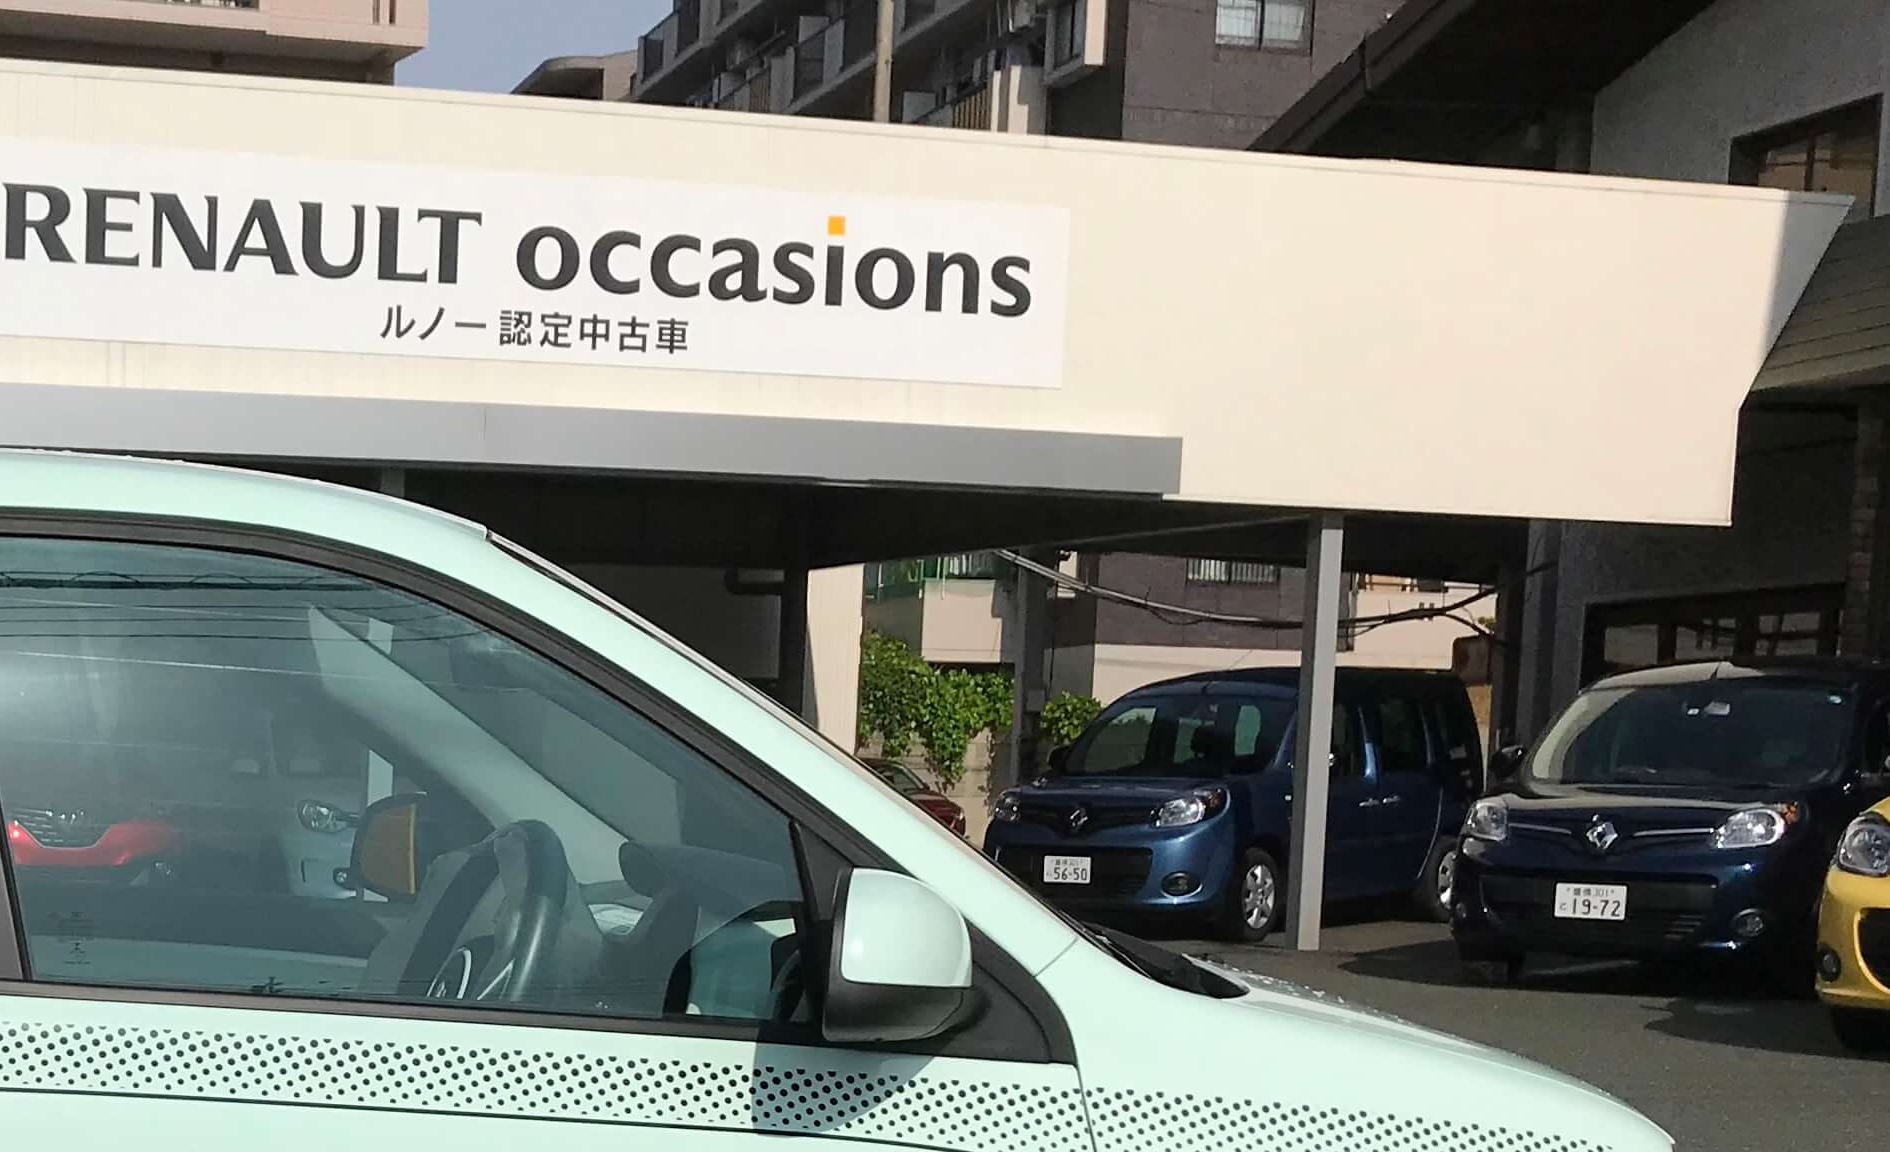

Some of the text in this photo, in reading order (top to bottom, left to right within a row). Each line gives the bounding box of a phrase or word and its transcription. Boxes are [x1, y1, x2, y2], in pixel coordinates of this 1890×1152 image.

[3, 183, 1031, 318] RENAULT occasions
[1572, 898, 1621, 917] 19-72
